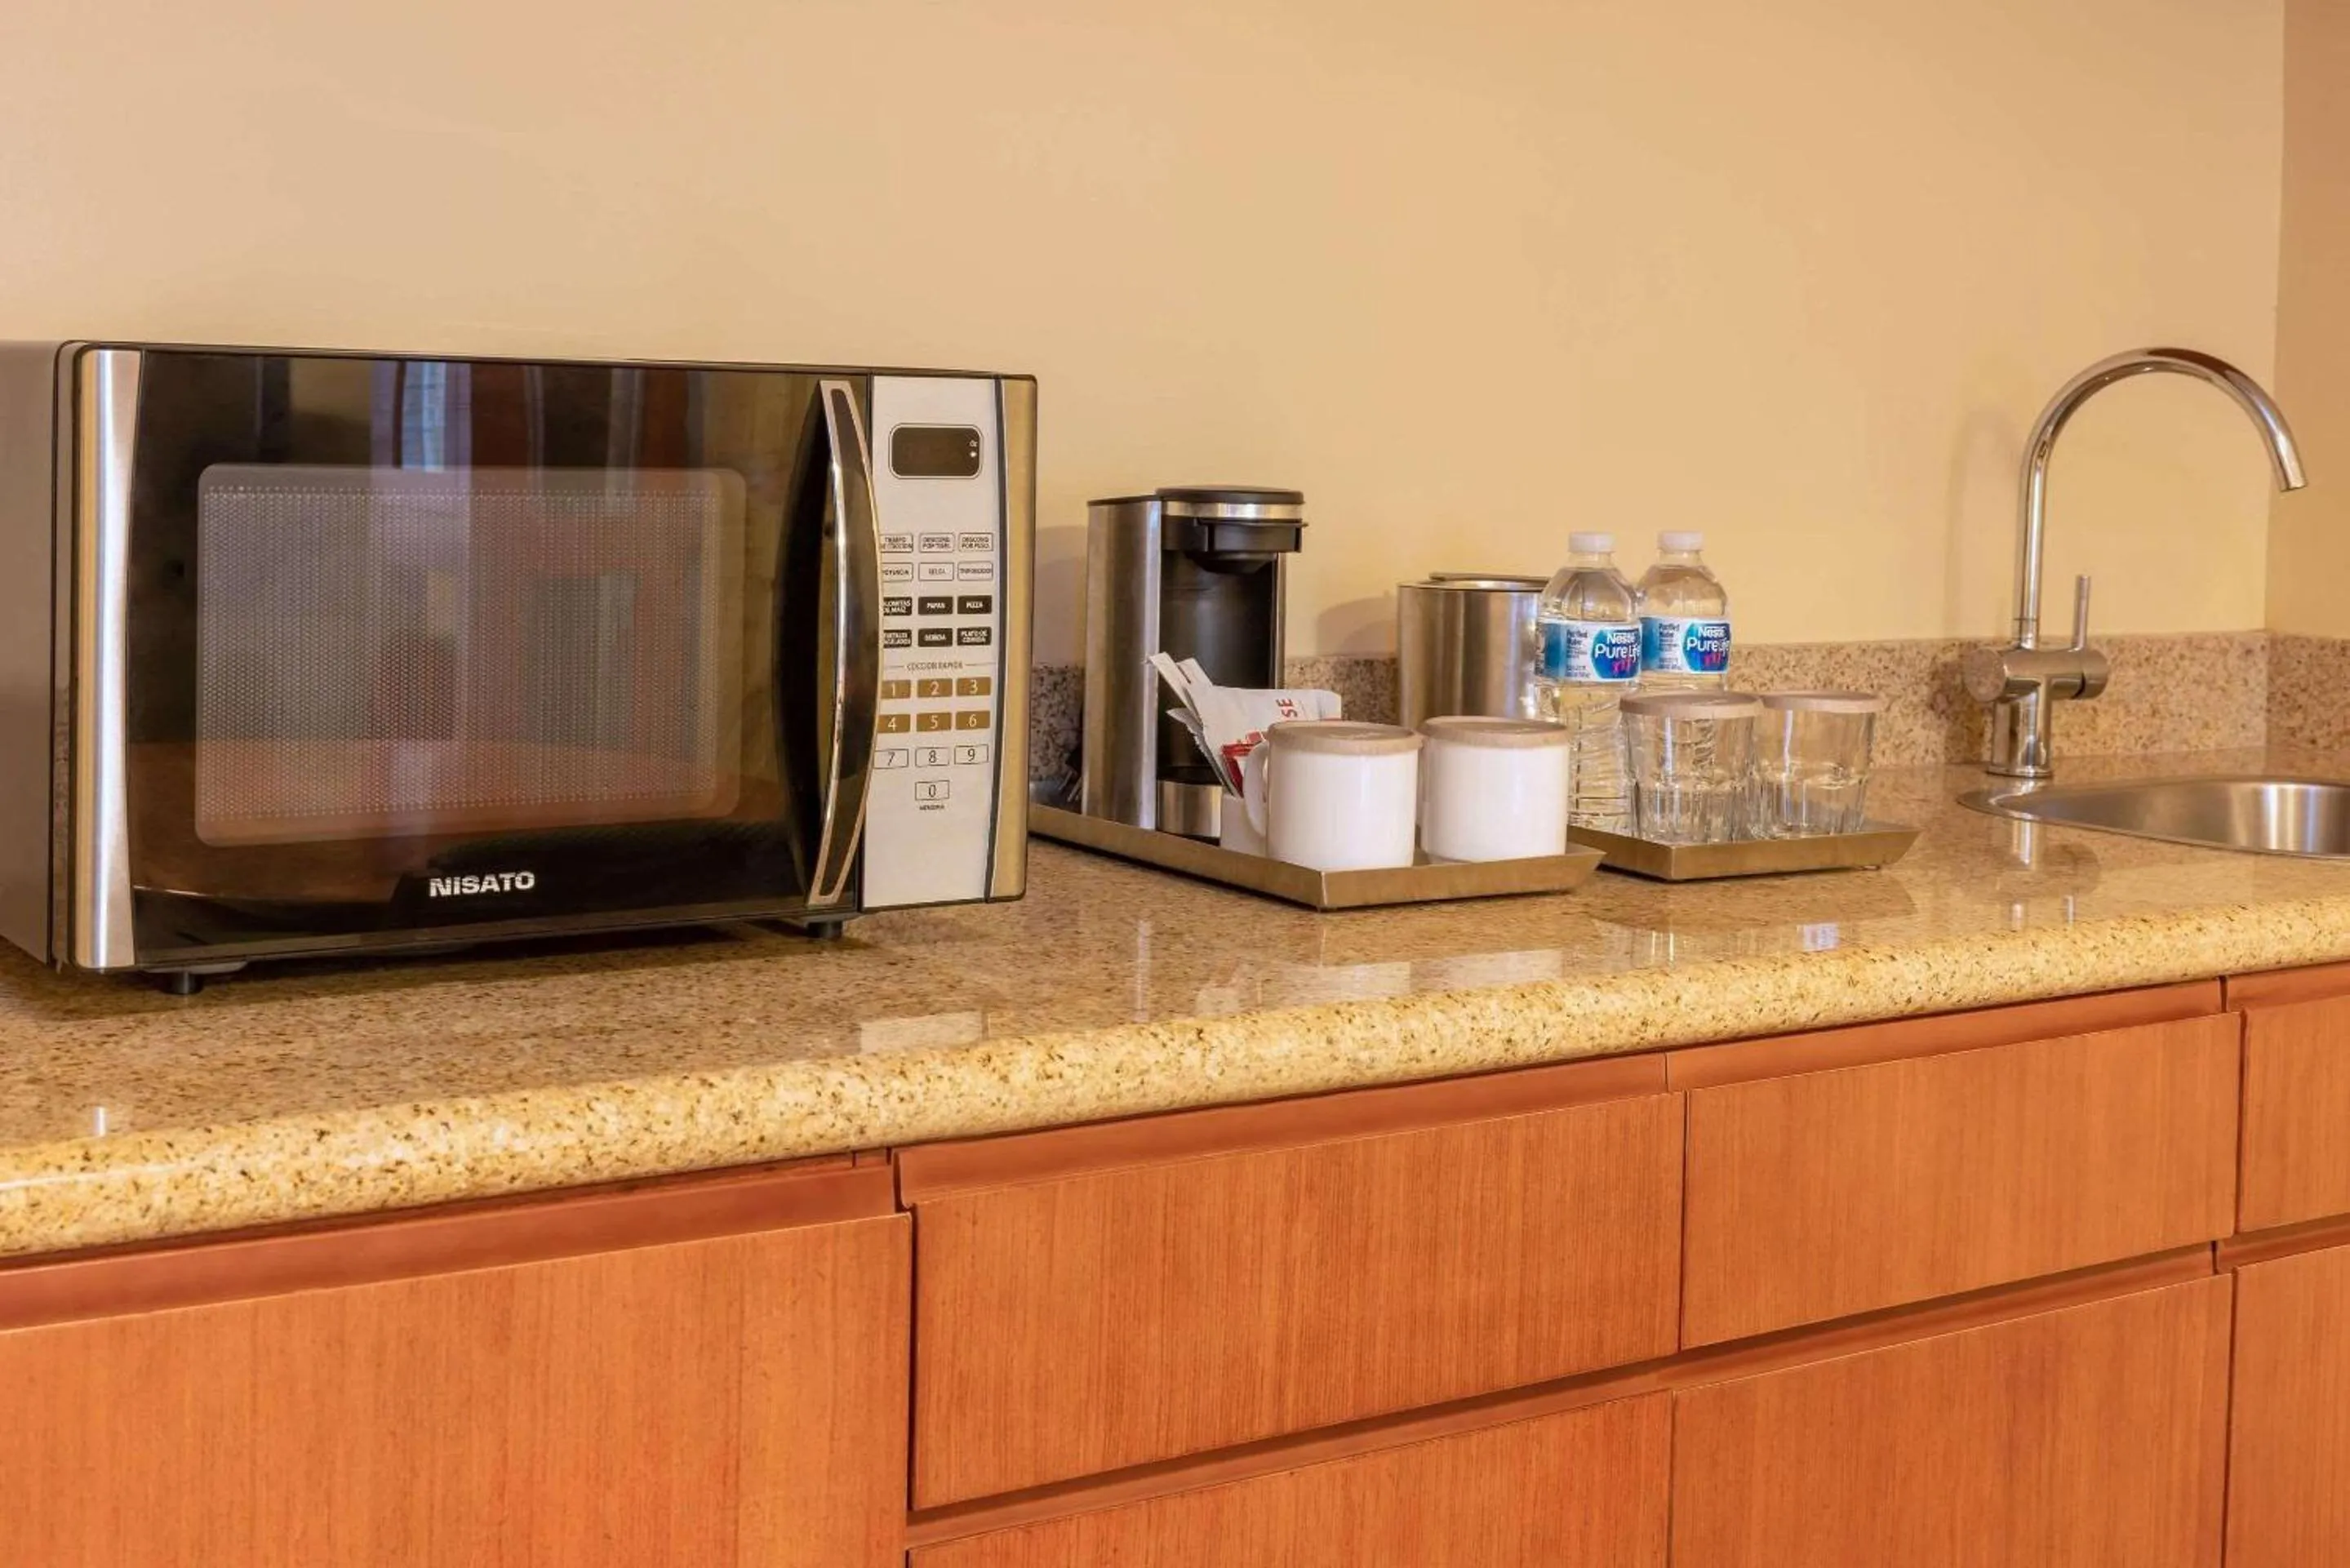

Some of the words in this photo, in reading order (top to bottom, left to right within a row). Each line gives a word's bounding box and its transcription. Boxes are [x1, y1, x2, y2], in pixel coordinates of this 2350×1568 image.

[930, 681, 940, 696] 2
[969, 679, 979, 695] 3
[887, 717, 897, 731] 4
[930, 715, 939, 730] 5
[968, 713, 977, 727] 6
[887, 751, 895, 766] 7
[928, 749, 938, 763] 8
[967, 748, 976, 762] 9
[928, 784, 937, 797] 0
[429, 871, 535, 898] NISATO
